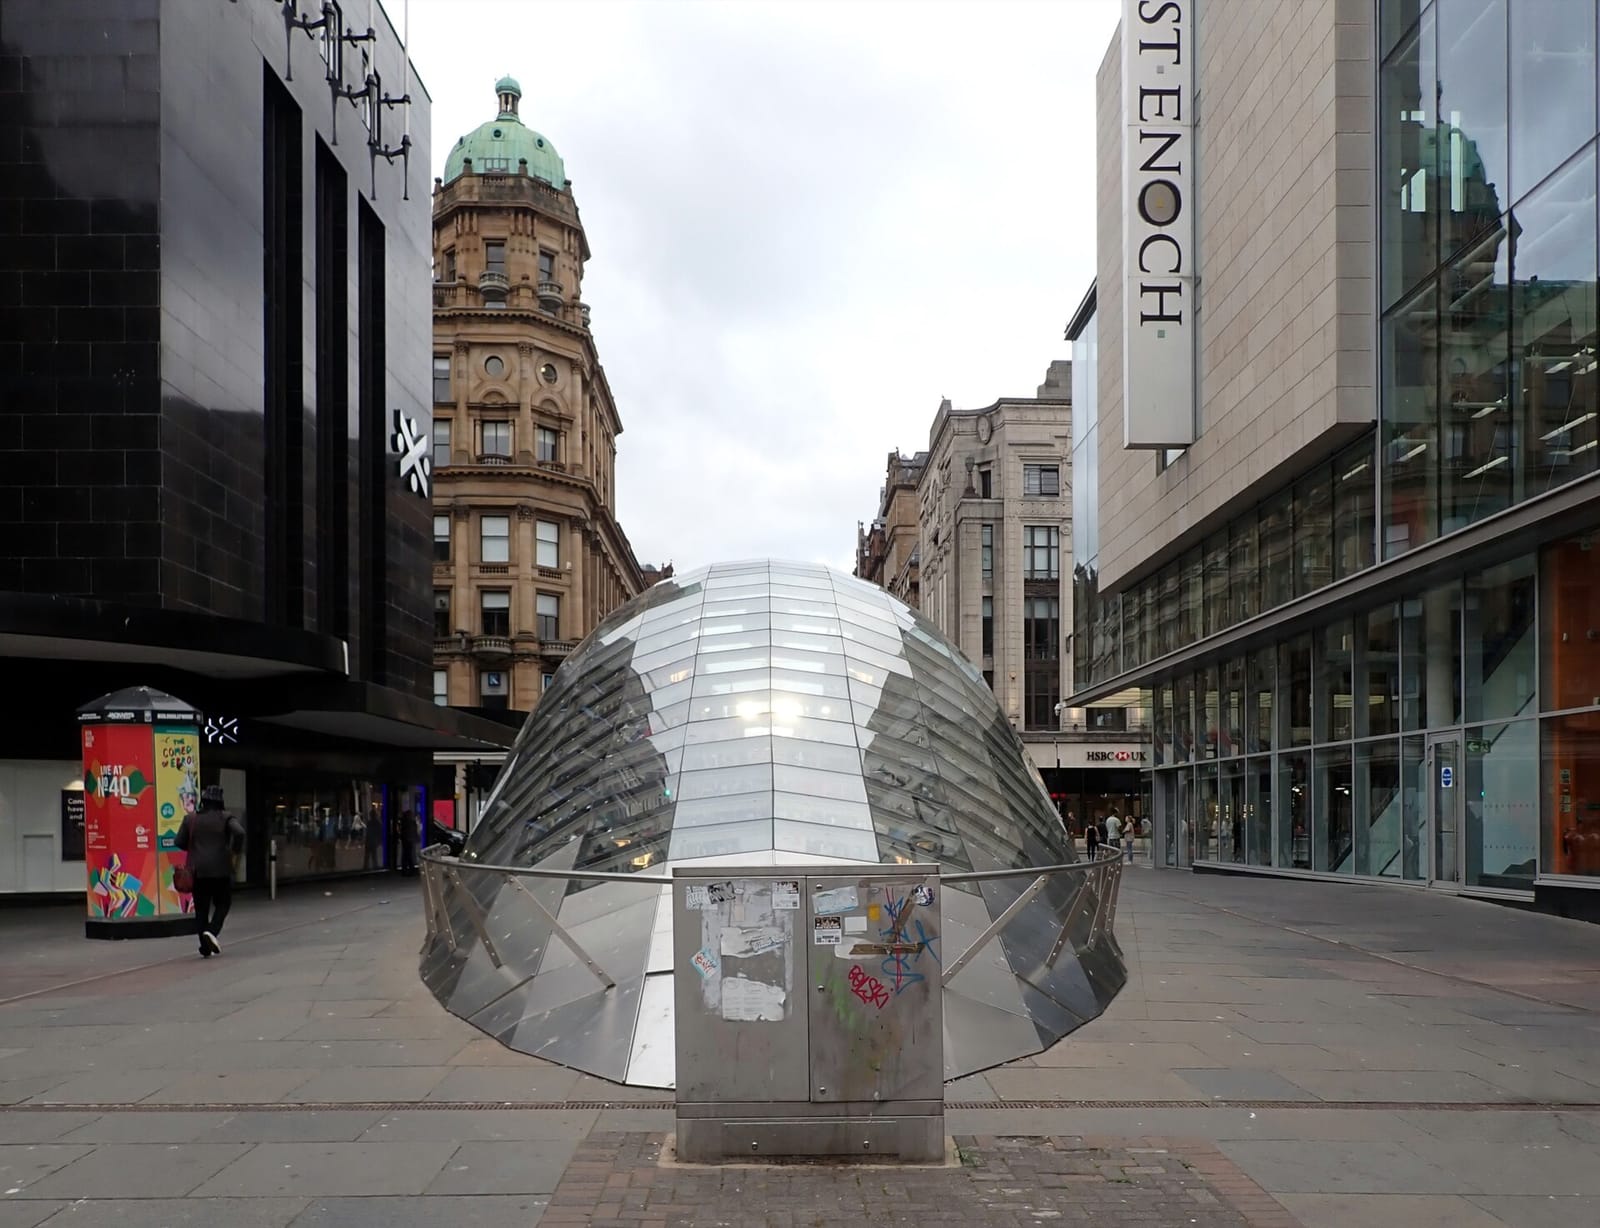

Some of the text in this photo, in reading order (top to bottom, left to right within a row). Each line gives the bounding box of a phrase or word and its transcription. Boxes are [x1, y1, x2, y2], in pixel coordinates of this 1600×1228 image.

[1138, 0, 1182, 327] ST ENOCH
[163, 745, 192, 758] COMED
[1086, 751, 1147, 761] HSBC UK
[113, 764, 123, 775] AT
